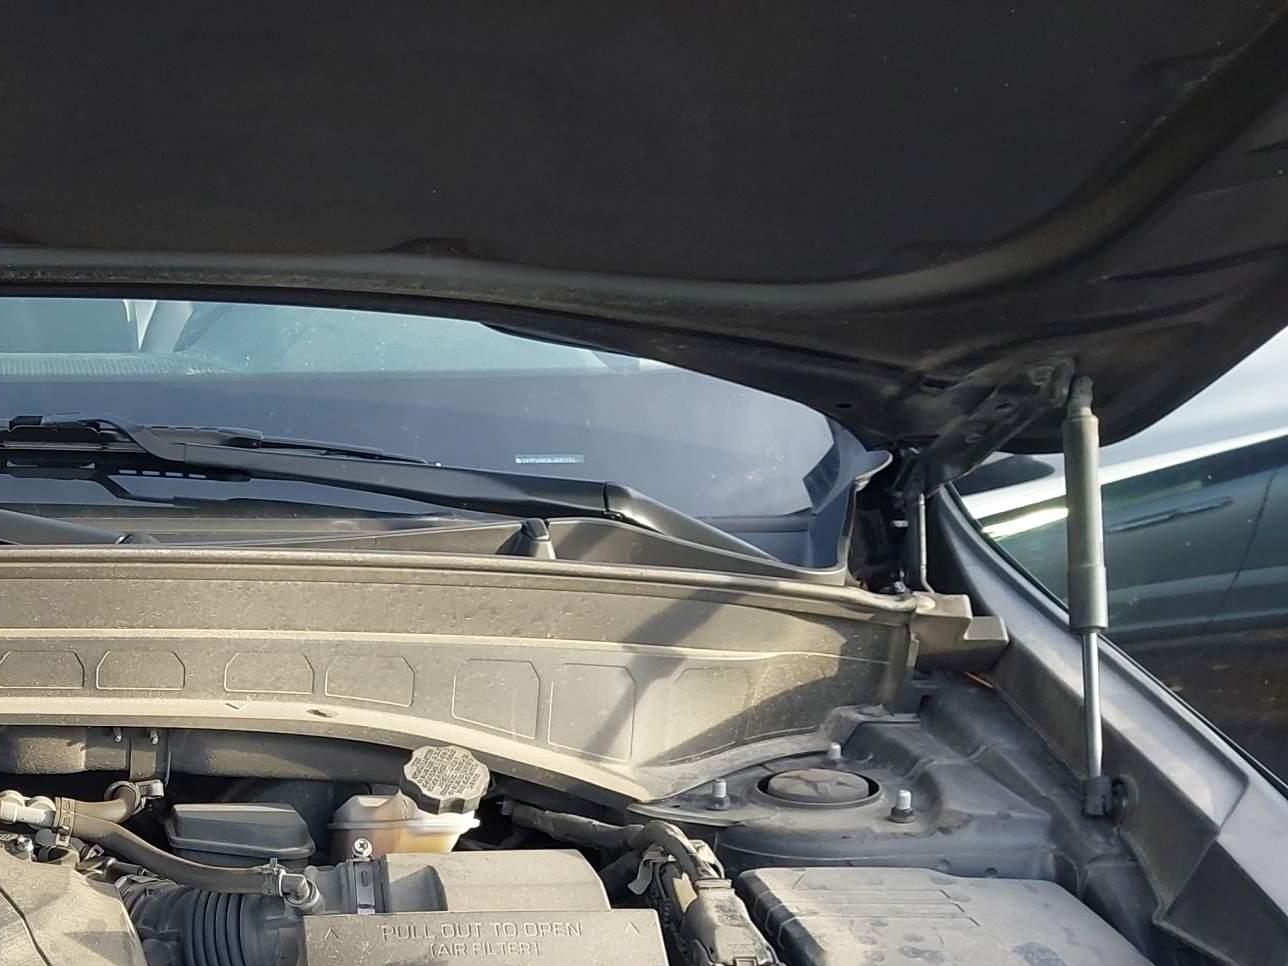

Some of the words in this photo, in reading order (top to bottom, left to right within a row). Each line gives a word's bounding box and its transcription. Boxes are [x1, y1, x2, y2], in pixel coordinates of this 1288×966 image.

[381, 925, 436, 940] PULL
[441, 923, 482, 939] OUT
[489, 922, 519, 938] TO
[524, 922, 583, 938] OPEN
